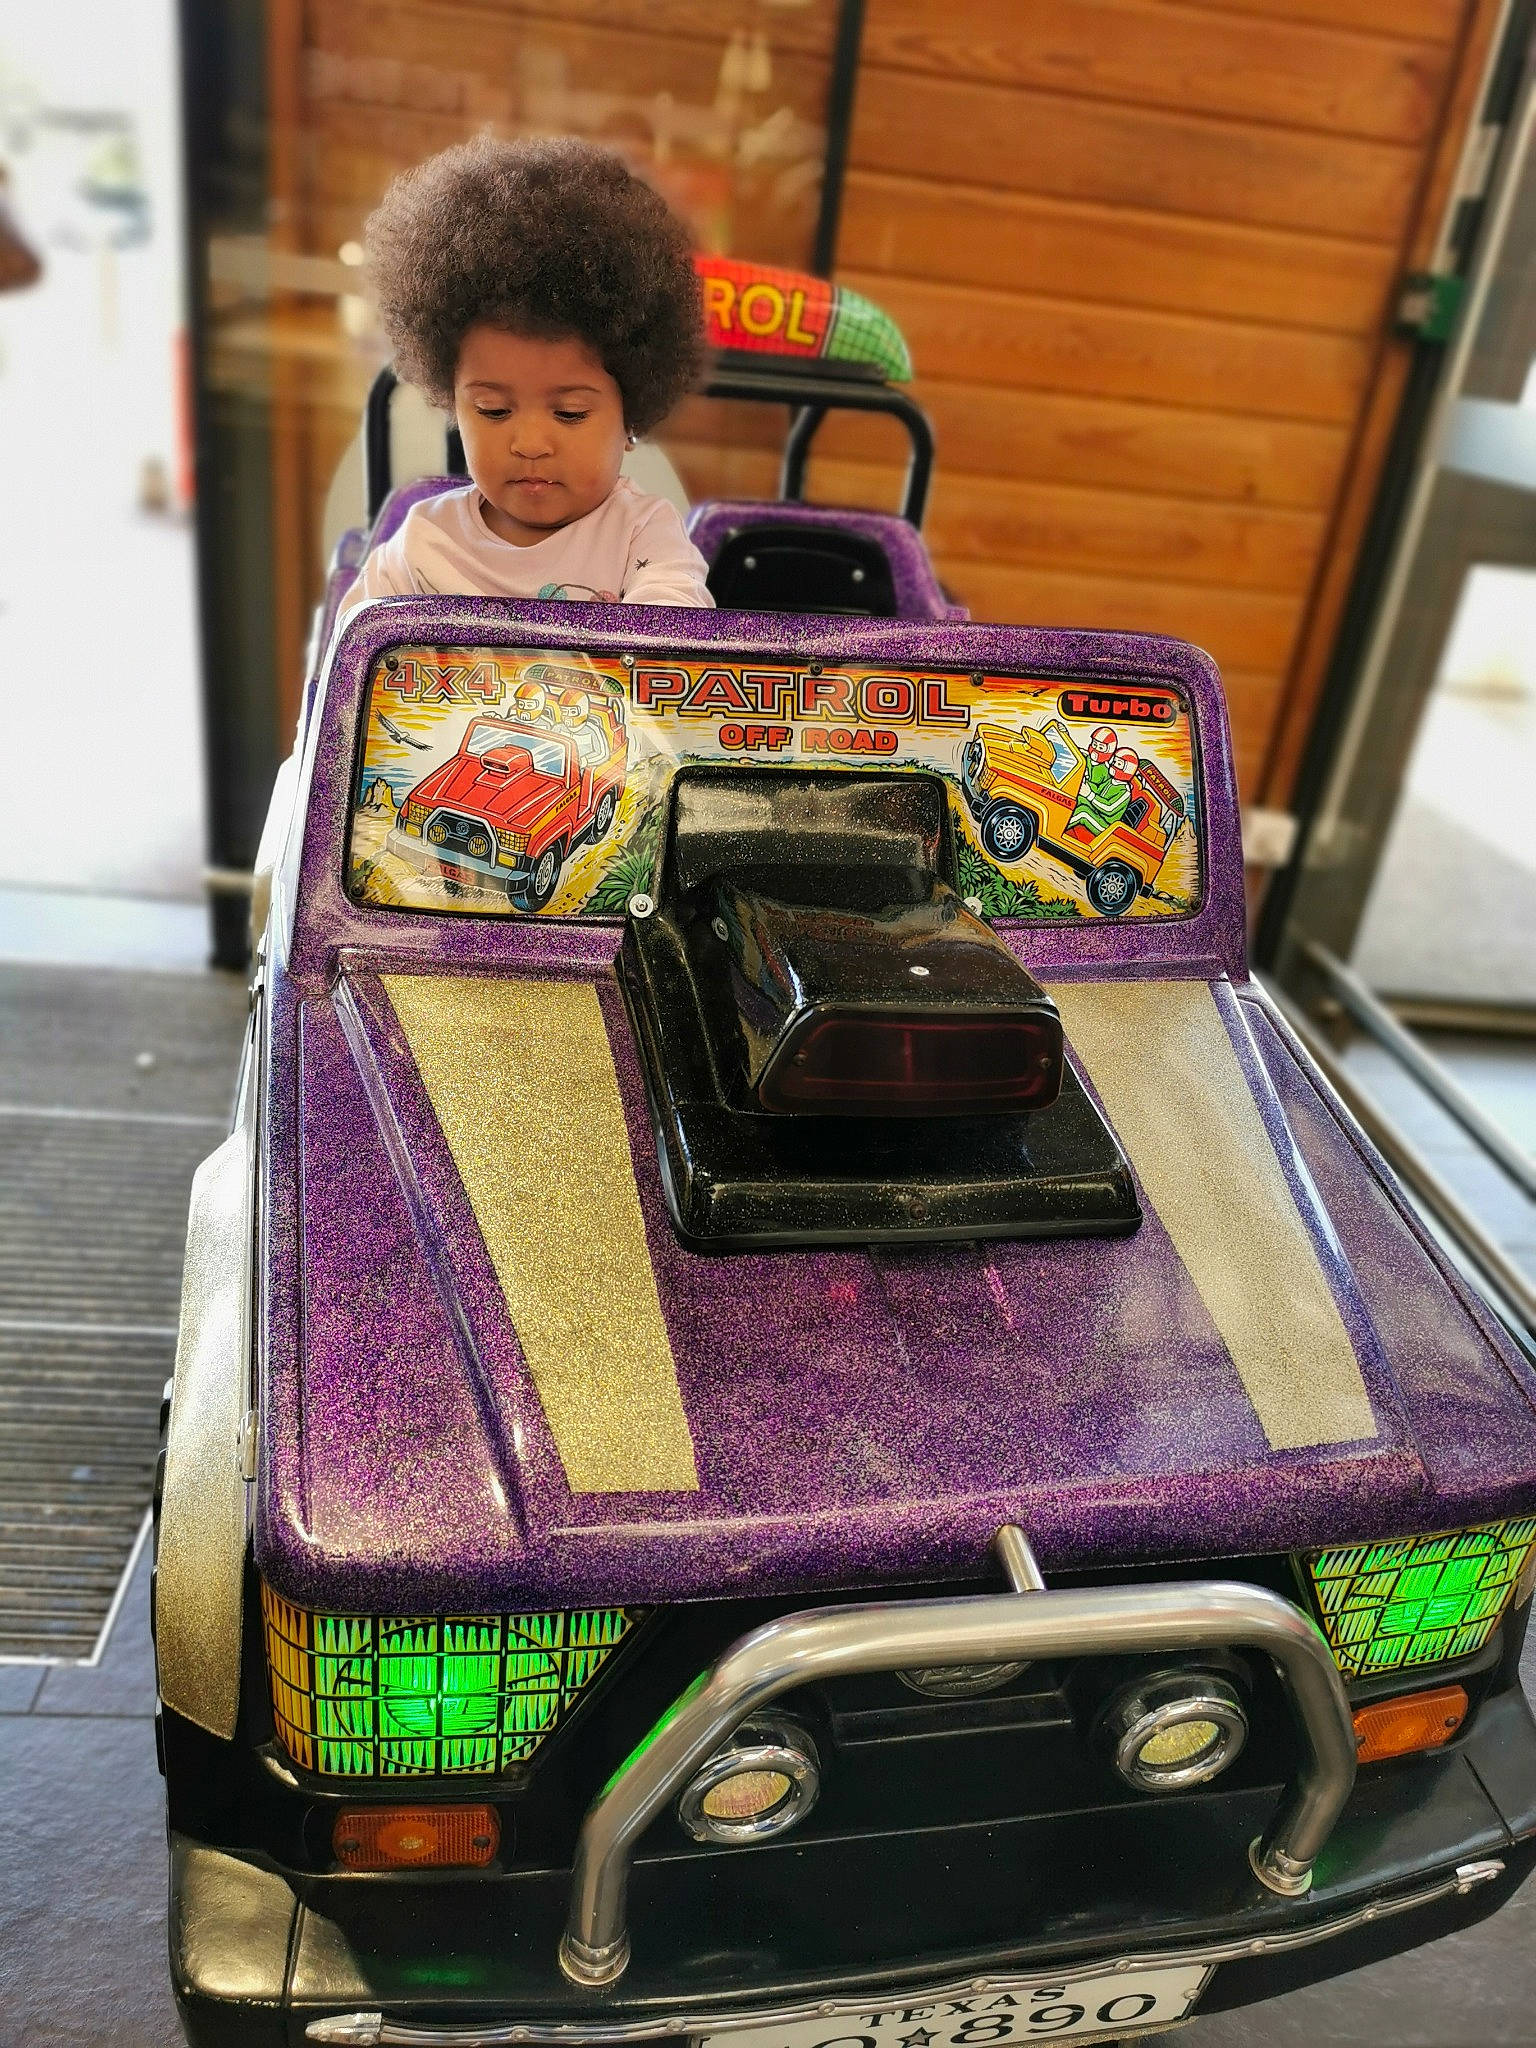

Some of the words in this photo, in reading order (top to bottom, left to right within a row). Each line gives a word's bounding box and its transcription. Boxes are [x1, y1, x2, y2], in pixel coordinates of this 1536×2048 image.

[546, 671, 598, 688] PATROL
[632, 668, 972, 728] PATROL
[1067, 693, 1172, 719] Turbo
[719, 724, 793, 751] OFF
[802, 727, 898, 754] ROAD
[1040, 787, 1073, 807] FALGAS
[1146, 769, 1171, 799] PATROL
[859, 1985, 1066, 2029] TEXAS
[950, 1993, 1157, 2044] 890
